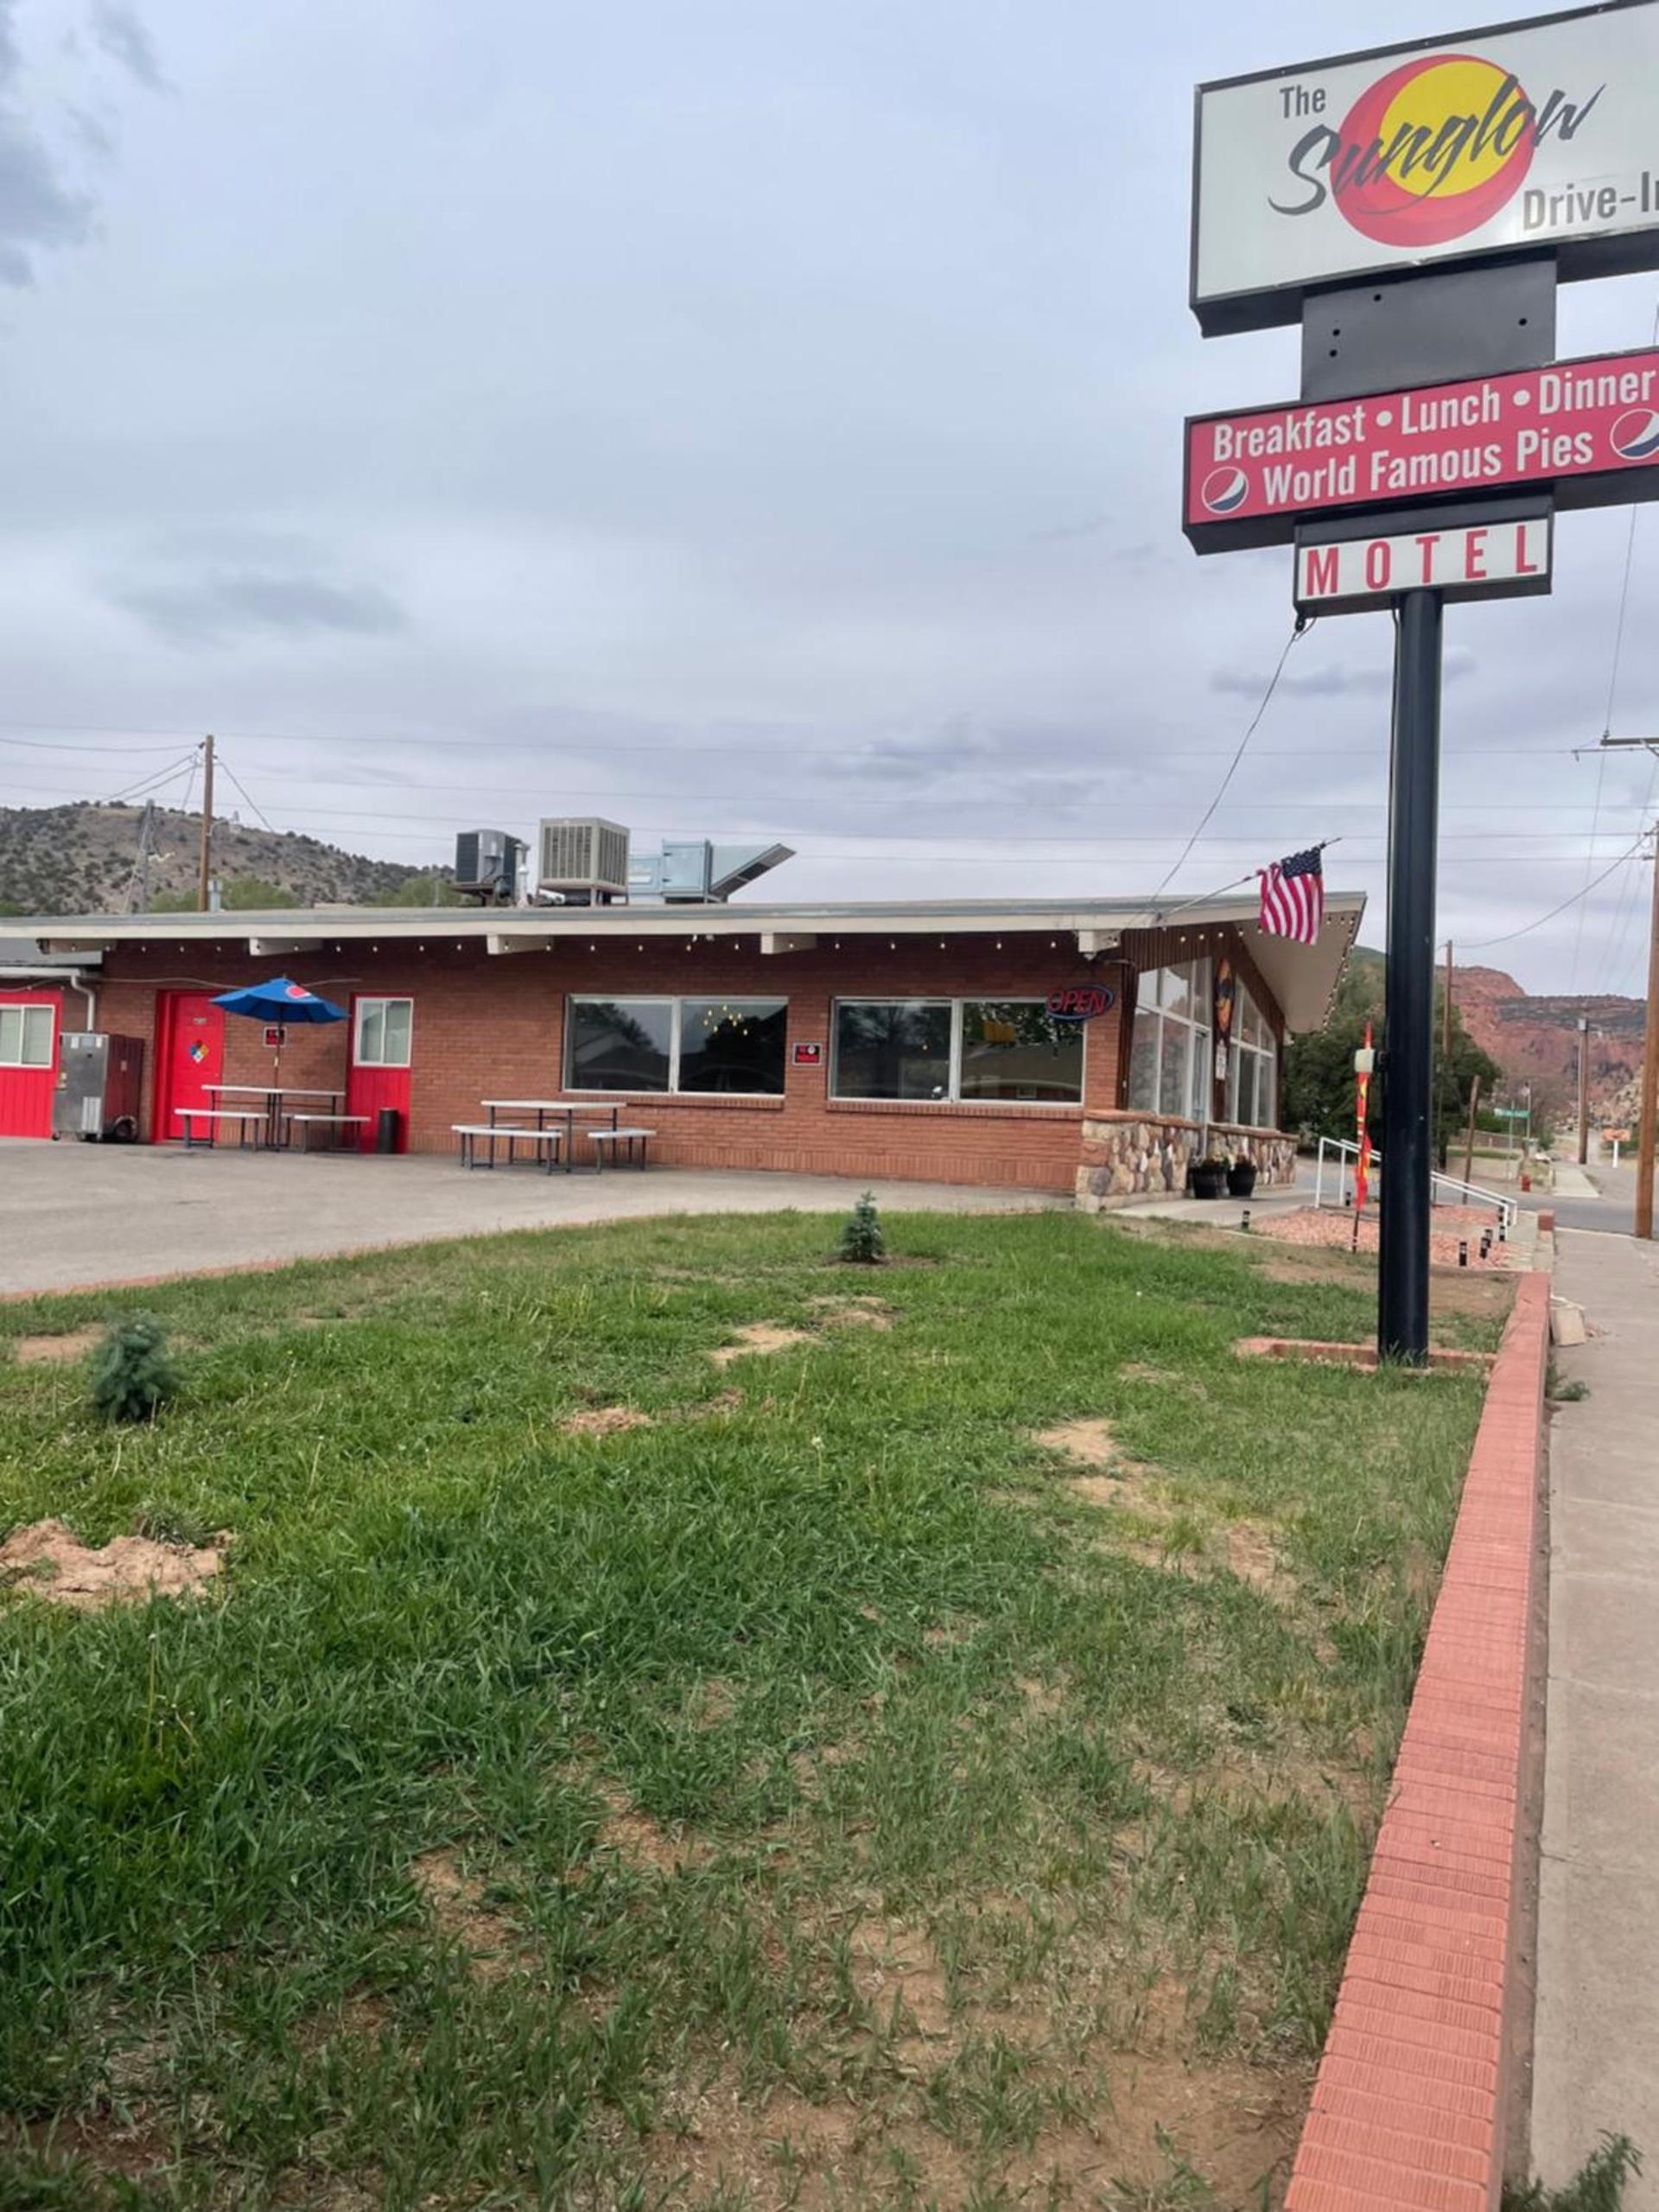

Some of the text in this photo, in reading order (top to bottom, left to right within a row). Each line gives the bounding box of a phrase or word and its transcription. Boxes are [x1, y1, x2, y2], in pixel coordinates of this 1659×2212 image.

[1280, 86, 1325, 118] The
[1268, 74, 1606, 216] Sunglow
[1524, 171, 1659, 230] Drive-I
[1213, 369, 1656, 461] Breakfast Lunch Dinner
[1262, 429, 1592, 505] World Famous Pies
[1306, 525, 1537, 596] MOTEL
[1047, 989, 1106, 1015] OPEN
